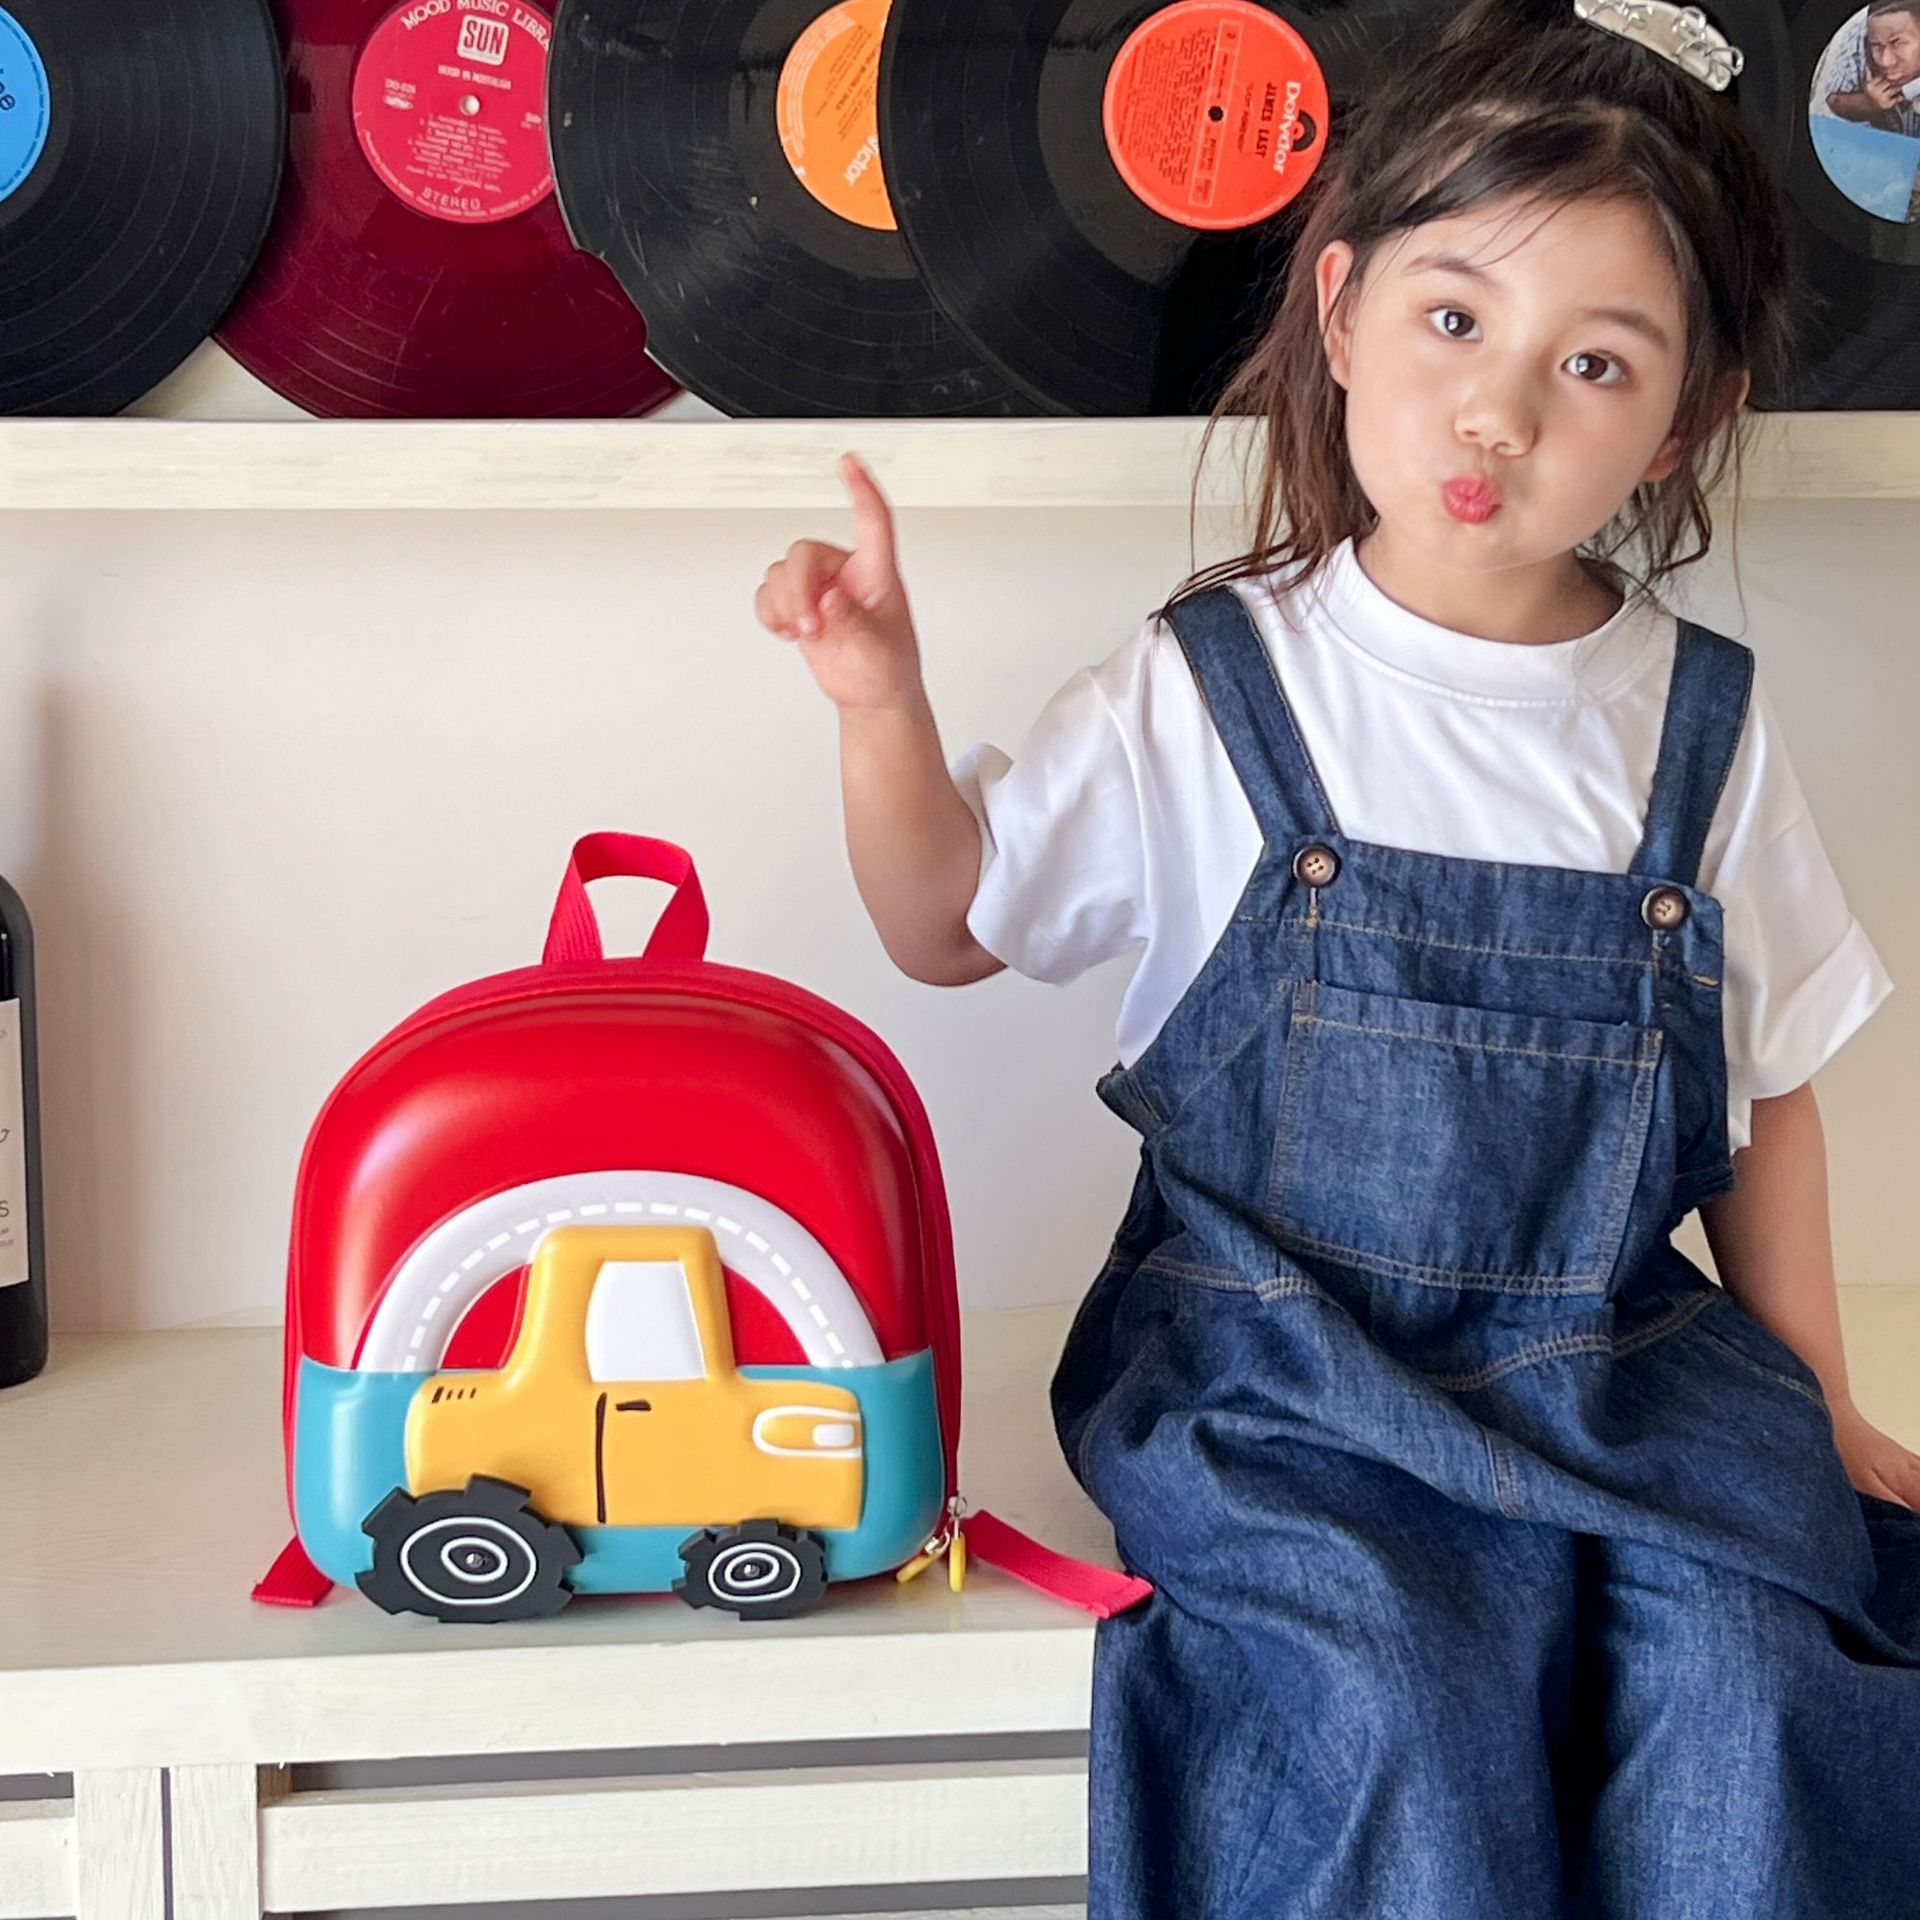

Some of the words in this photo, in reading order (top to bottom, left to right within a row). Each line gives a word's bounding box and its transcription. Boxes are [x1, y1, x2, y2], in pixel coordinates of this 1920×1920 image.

[401, 0, 451, 30] MOOD
[457, 0, 510, 17] MUSIC
[463, 20, 505, 54] SUN
[1261, 82, 1277, 122] JAMES
[1255, 127, 1269, 159] LAST
[1273, 81, 1302, 174] Polydor
[421, 186, 481, 210] STEREO
